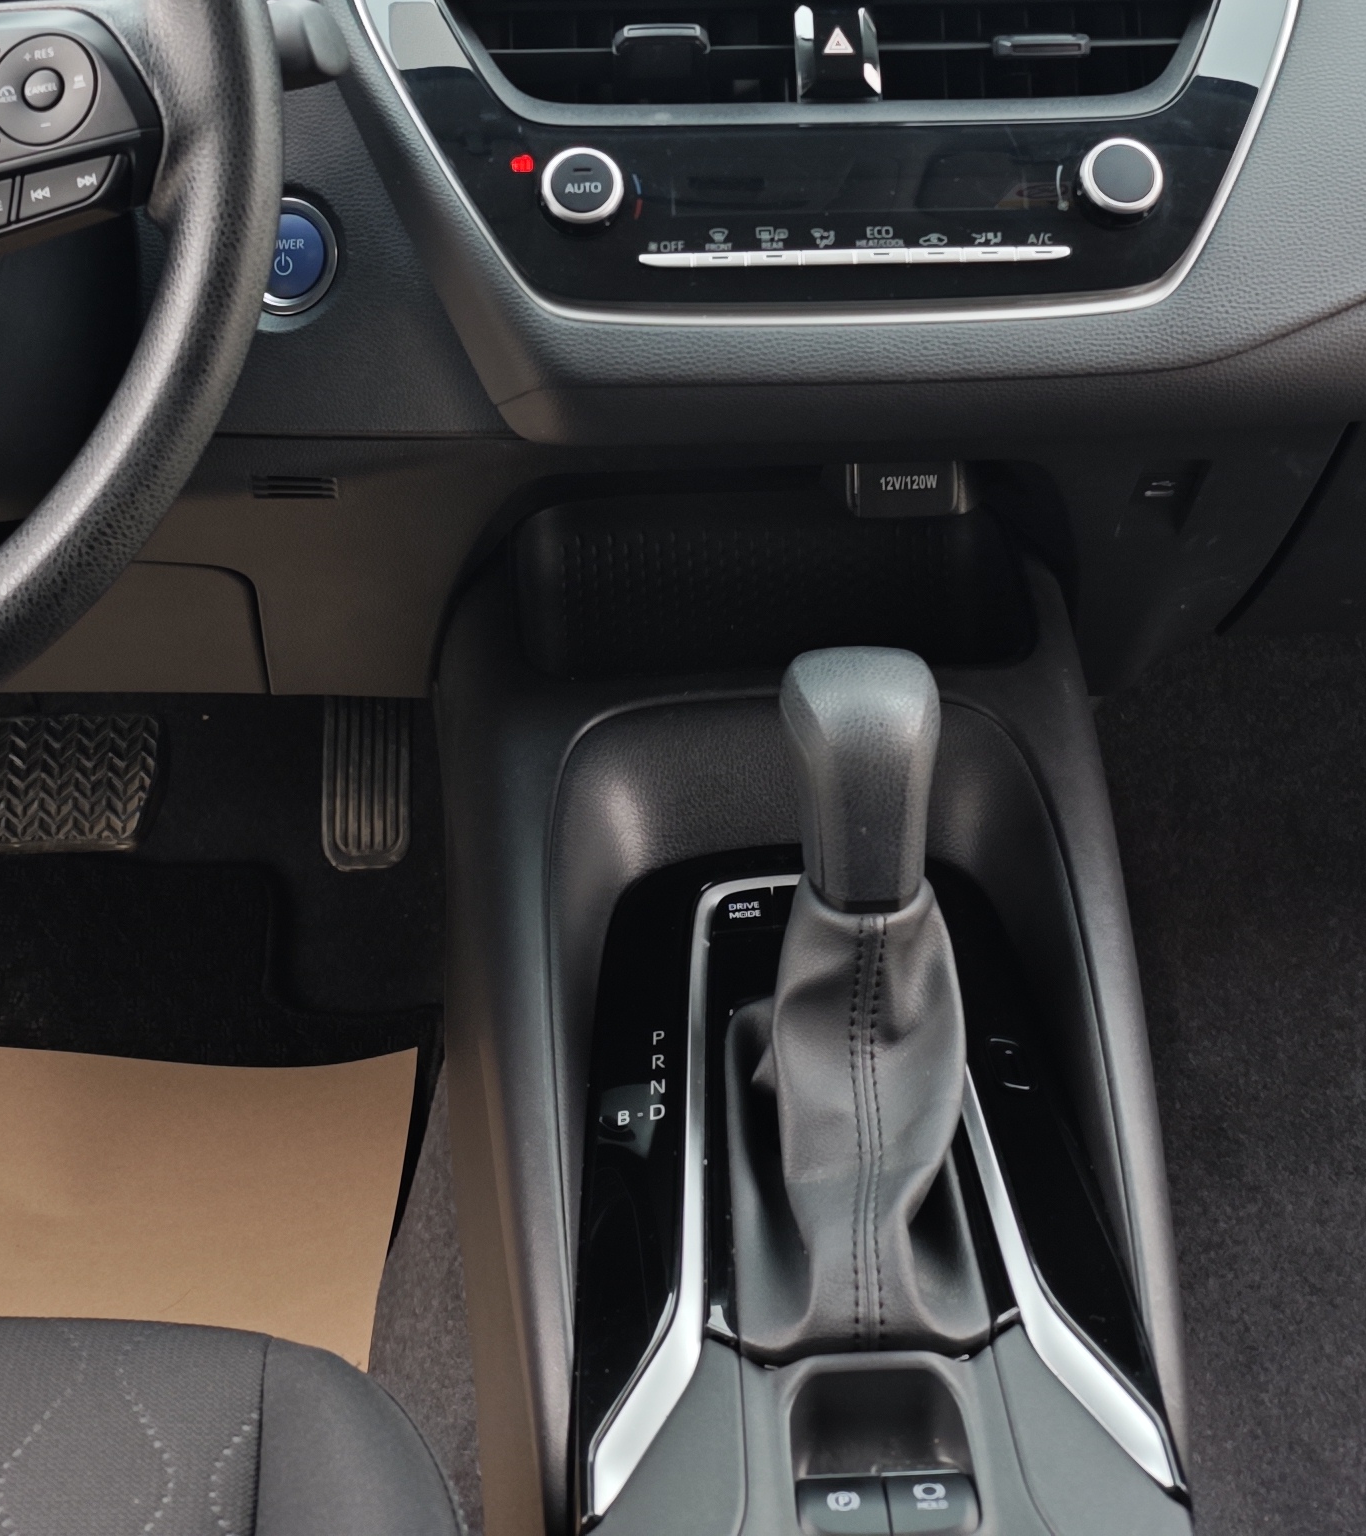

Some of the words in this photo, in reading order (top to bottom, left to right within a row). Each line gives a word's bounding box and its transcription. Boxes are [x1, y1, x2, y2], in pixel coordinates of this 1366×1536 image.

[34, 46, 55, 61] RES
[25, 82, 58, 97] CANCEL
[564, 181, 602, 194] AUTO
[866, 225, 894, 239] ECO
[1027, 232, 1053, 245] A/C
[275, 238, 305, 251] WER
[659, 240, 685, 253] OFF
[705, 242, 733, 251] FRONT
[761, 241, 784, 250] REAR
[855, 238, 905, 248] HEAT/COOL
[879, 474, 938, 491] 12V/120W
[728, 900, 760, 911] DRIVE
[728, 910, 762, 920] MODE
[652, 1030, 665, 1046] P
[651, 1054, 666, 1070] R
[650, 1078, 666, 1095] N
[617, 1110, 631, 1126] B
[649, 1104, 666, 1121] D
